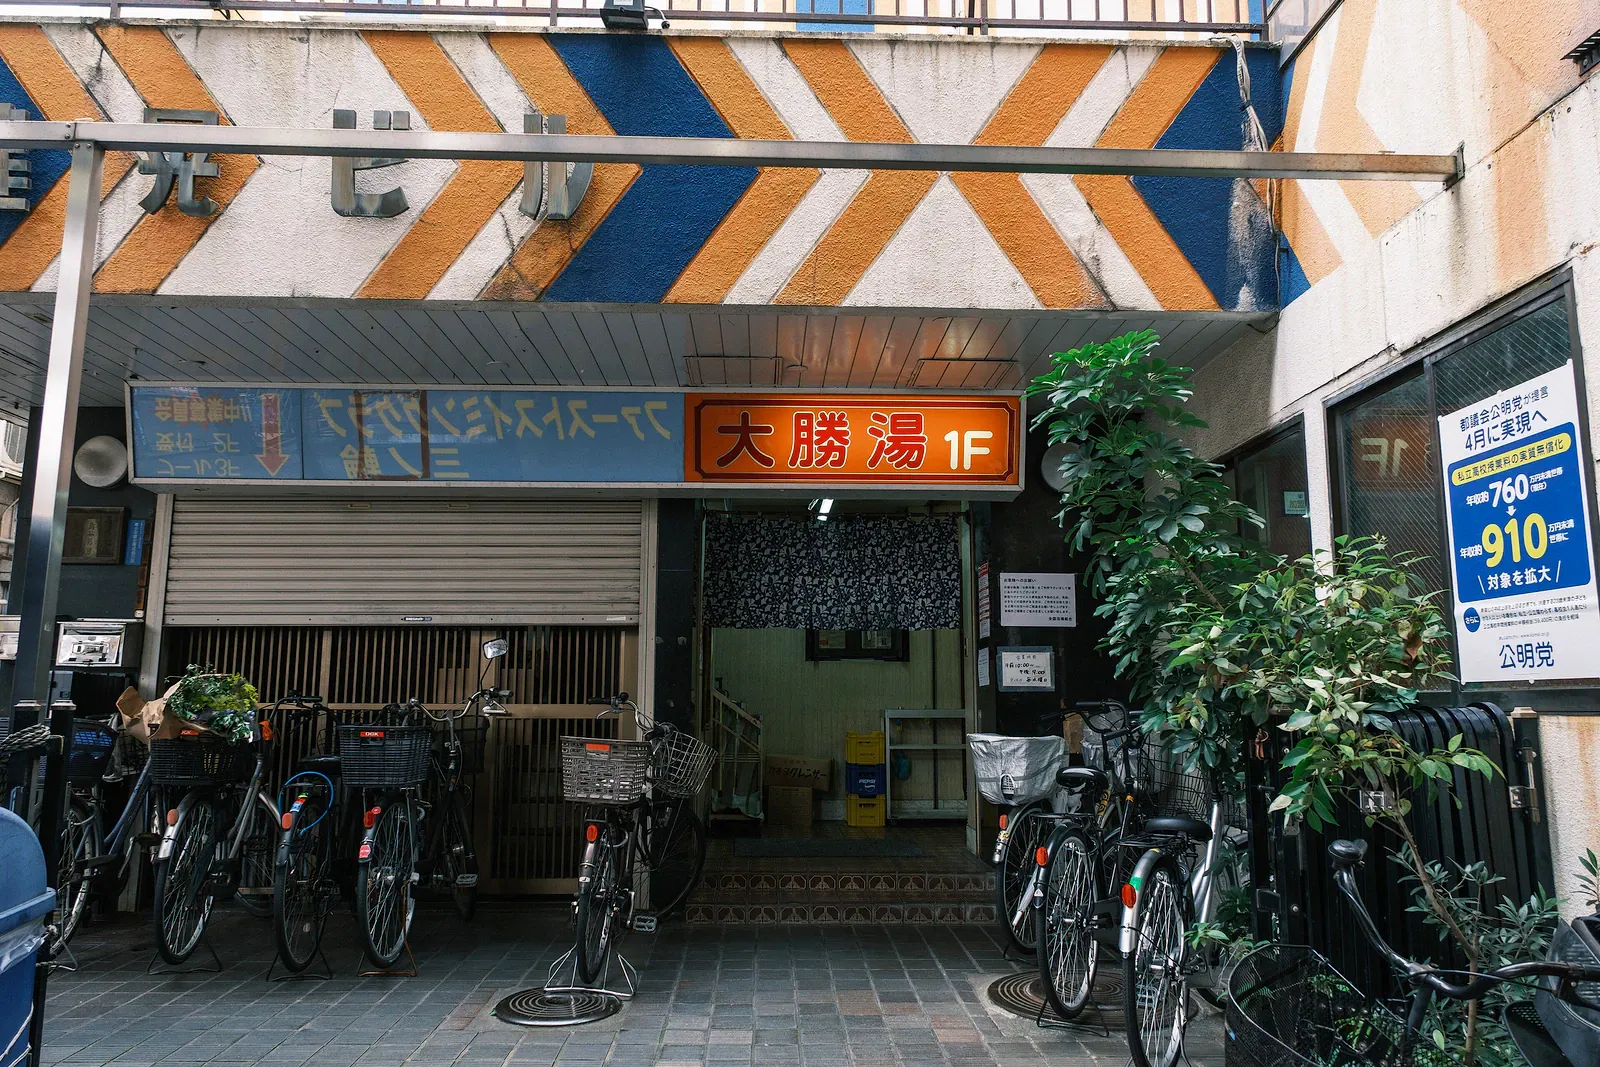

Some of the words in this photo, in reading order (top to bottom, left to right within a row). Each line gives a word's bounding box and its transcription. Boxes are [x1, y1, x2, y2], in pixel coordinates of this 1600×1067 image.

[1460, 386, 1549, 432] 都議会公明党が提言
[716, 409, 928, 469] 大勝湯
[943, 430, 993, 469] 1F
[1465, 410, 1548, 451] 4月に実現へ
[1457, 438, 1564, 482] 私立高校授業料の実質無償化
[1489, 473, 1529, 508] 760
[1481, 512, 1548, 568] 910
[1487, 565, 1552, 591] 対象を拡大
[1498, 641, 1555, 669] 公明党
